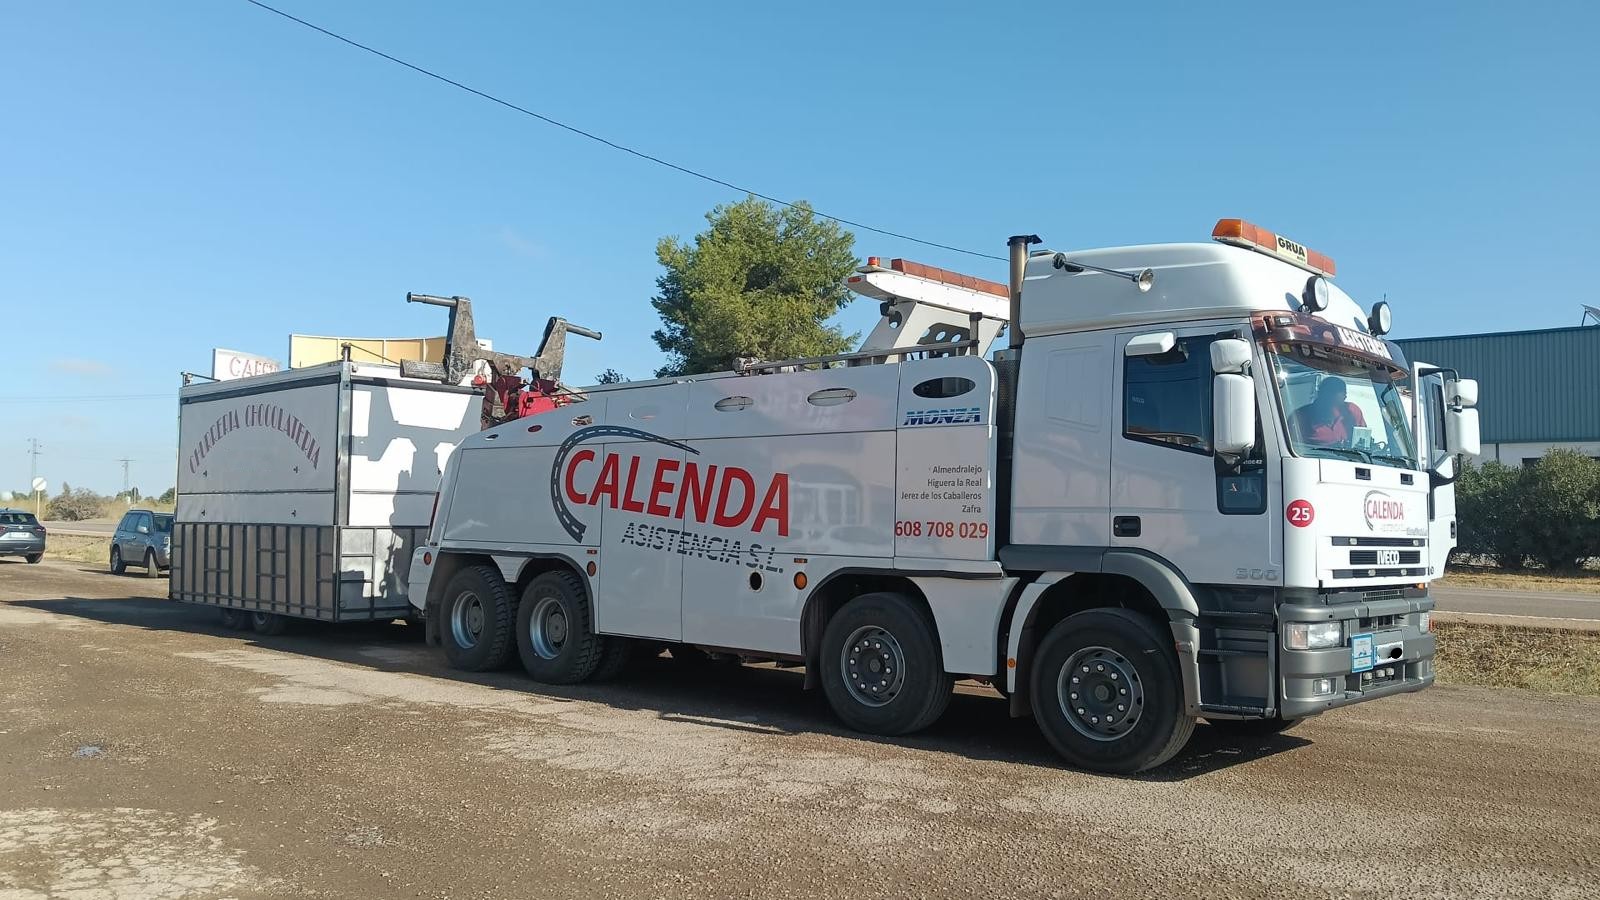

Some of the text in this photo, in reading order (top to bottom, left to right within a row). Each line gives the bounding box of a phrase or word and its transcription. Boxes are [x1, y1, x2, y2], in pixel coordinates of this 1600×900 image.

[1278, 237, 1305, 257] GRUA
[903, 407, 981, 425] MONZA
[245, 403, 321, 470] CHOCOLATERIA
[932, 465, 982, 475] Almendralejo
[927, 478, 982, 489] Higuera la Real
[565, 449, 790, 537] CALENDA
[901, 491, 982, 500] Jerez de los Caballeros
[961, 504, 982, 513] Zafra
[1291, 507, 1311, 521] 25
[1366, 499, 1404, 520] CALENDA
[894, 520, 988, 539] 608 708 029
[621, 522, 784, 574] ASISTENCIA S.L.
[1376, 549, 1400, 566] IVECO
